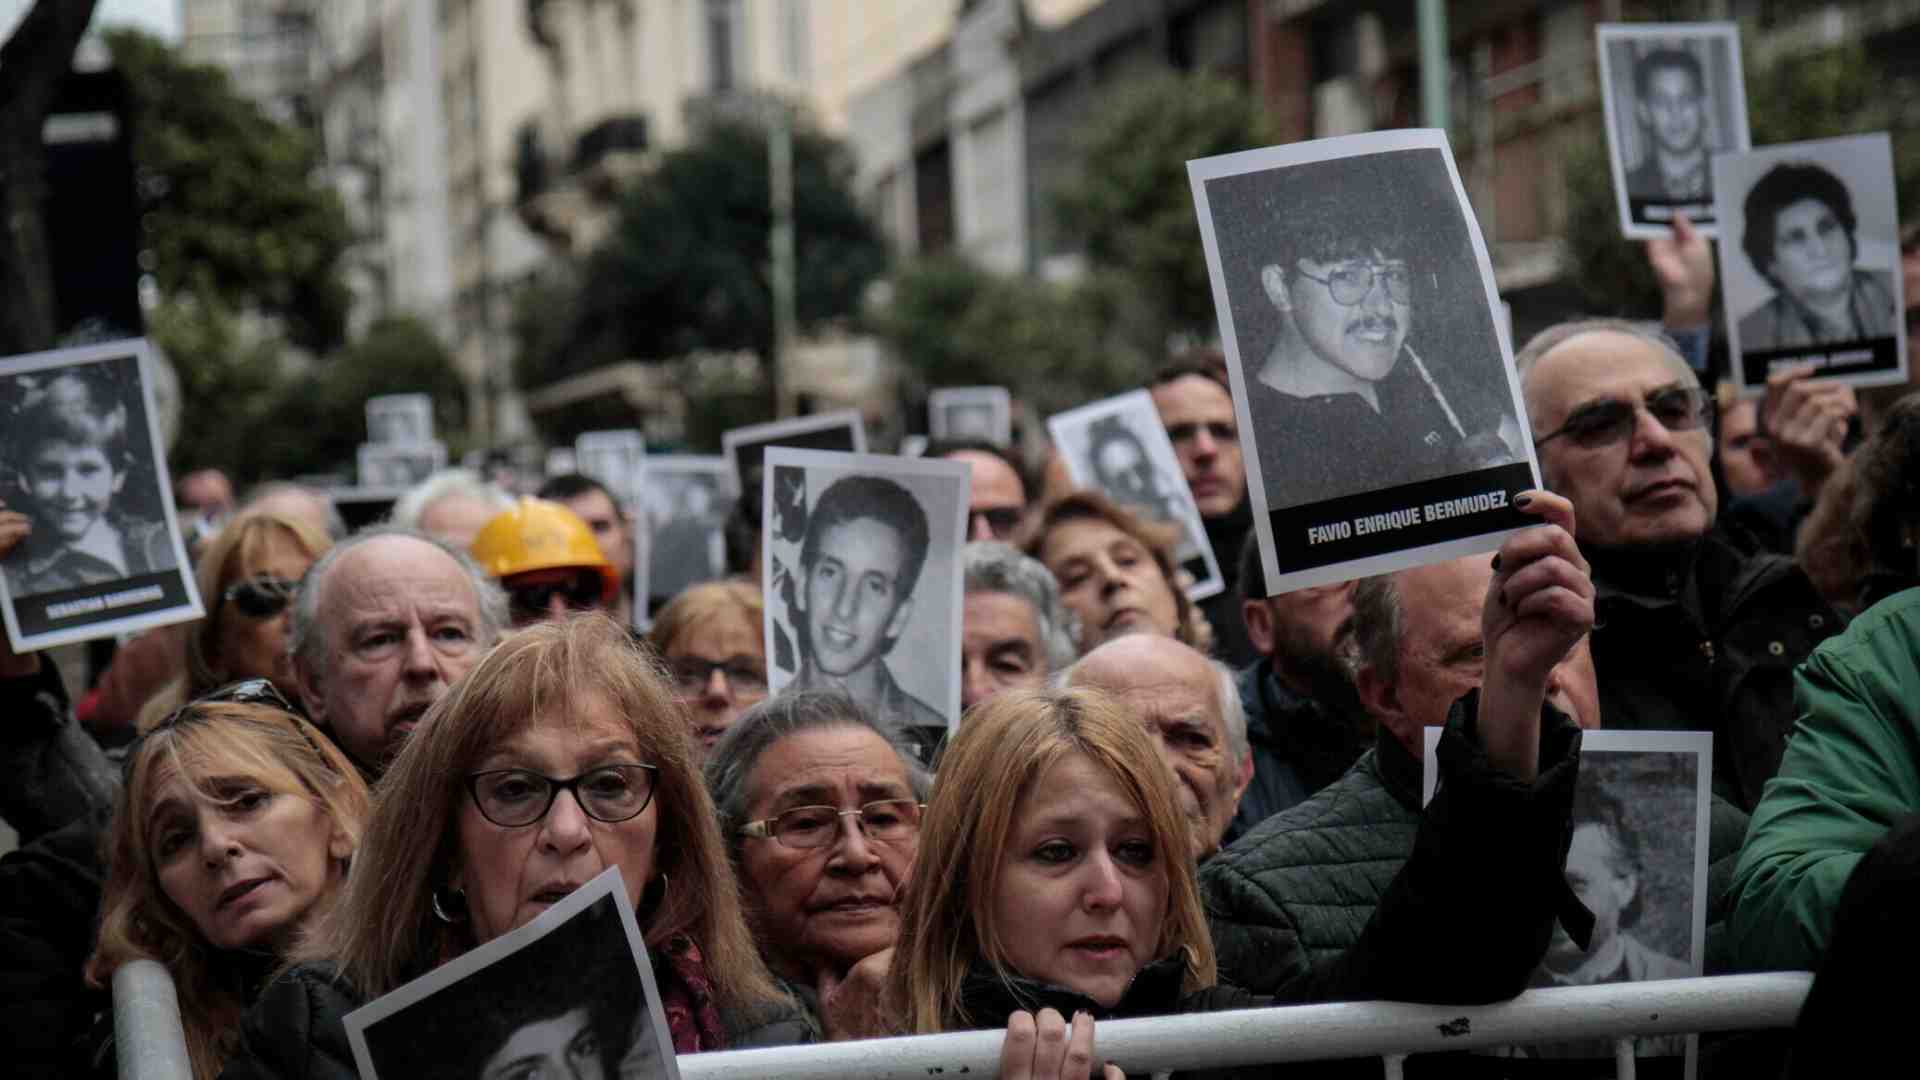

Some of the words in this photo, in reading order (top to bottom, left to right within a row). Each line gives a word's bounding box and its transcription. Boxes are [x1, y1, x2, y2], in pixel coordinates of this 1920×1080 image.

[1308, 520, 1351, 545] FAVIO
[1354, 506, 1422, 536] ENRIQUE
[1425, 490, 1509, 522] BERMUDEZ
